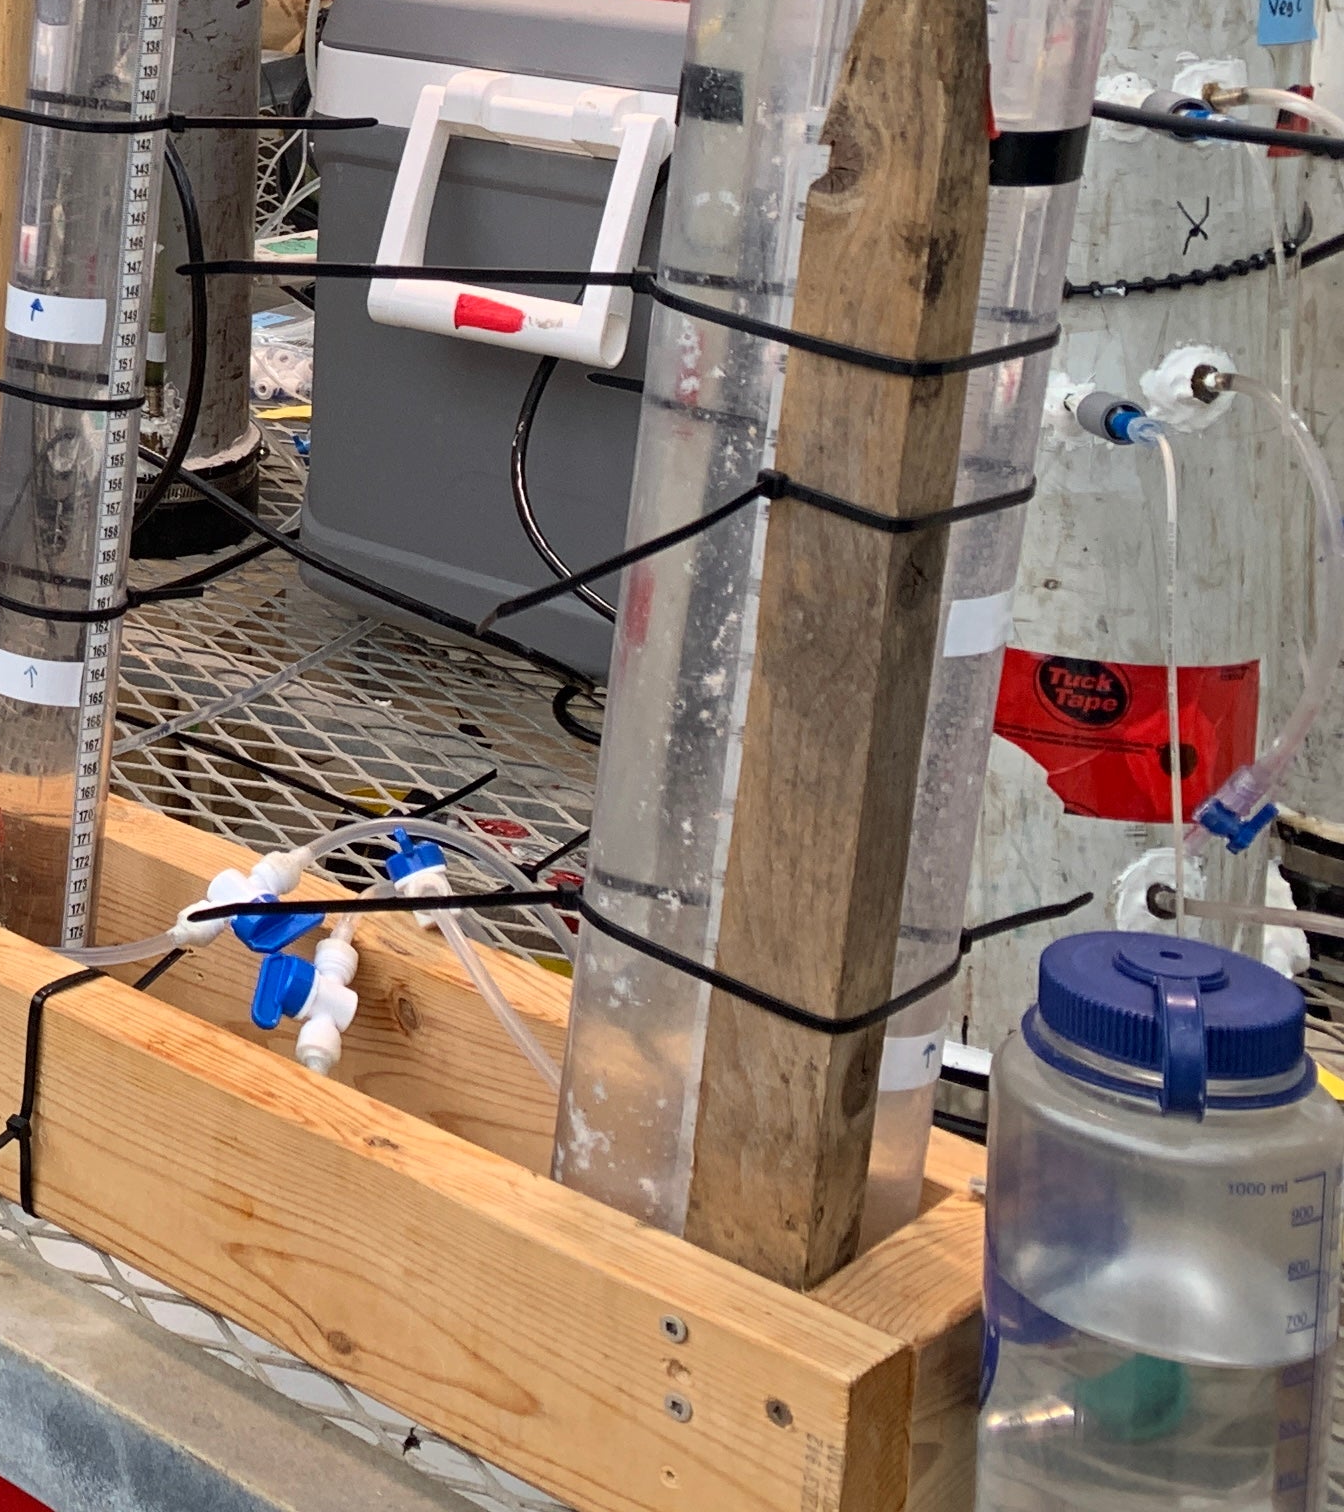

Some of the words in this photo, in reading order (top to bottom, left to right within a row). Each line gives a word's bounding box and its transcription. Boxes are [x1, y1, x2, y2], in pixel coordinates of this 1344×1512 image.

[148, 16, 163, 28] 137
[143, 65, 158, 77] 139
[141, 90, 155, 102] 140
[136, 139, 151, 151] 142
[134, 164, 149, 175] 143
[132, 188, 147, 200] 144
[131, 213, 145, 224] 145
[129, 237, 143, 248] 146
[126, 261, 141, 273] 147
[123, 310, 137, 322] 149
[120, 334, 136, 346] 150
[118, 358, 133, 370] 151
[115, 382, 130, 394] 152
[112, 431, 126, 443] 154
[110, 454, 124, 466] 155
[108, 478, 122, 490] 156
[106, 502, 120, 514] 157
[104, 526, 118, 538] 158
[102, 550, 116, 562] 159
[99, 573, 113, 585] 160
[96, 597, 110, 608] 161
[95, 621, 108, 633] 162
[92, 644, 107, 656] 163
[90, 669, 105, 681] 164
[1047, 666, 1112, 691] Tuck
[88, 692, 103, 704] 165
[1054, 688, 1119, 713] Tape
[84, 739, 100, 752] 167
[82, 763, 97, 775] 168
[80, 787, 95, 799] 169
[79, 810, 94, 822] 170
[77, 833, 91, 846] 171
[74, 856, 90, 869] 172
[73, 879, 87, 891] 173
[71, 903, 85, 916] 174
[69, 926, 83, 939] 175
[1227, 1182, 1266, 1196] 1000
[1270, 1180, 1288, 1194] ml
[1286, 1313, 1308, 1329] 700
